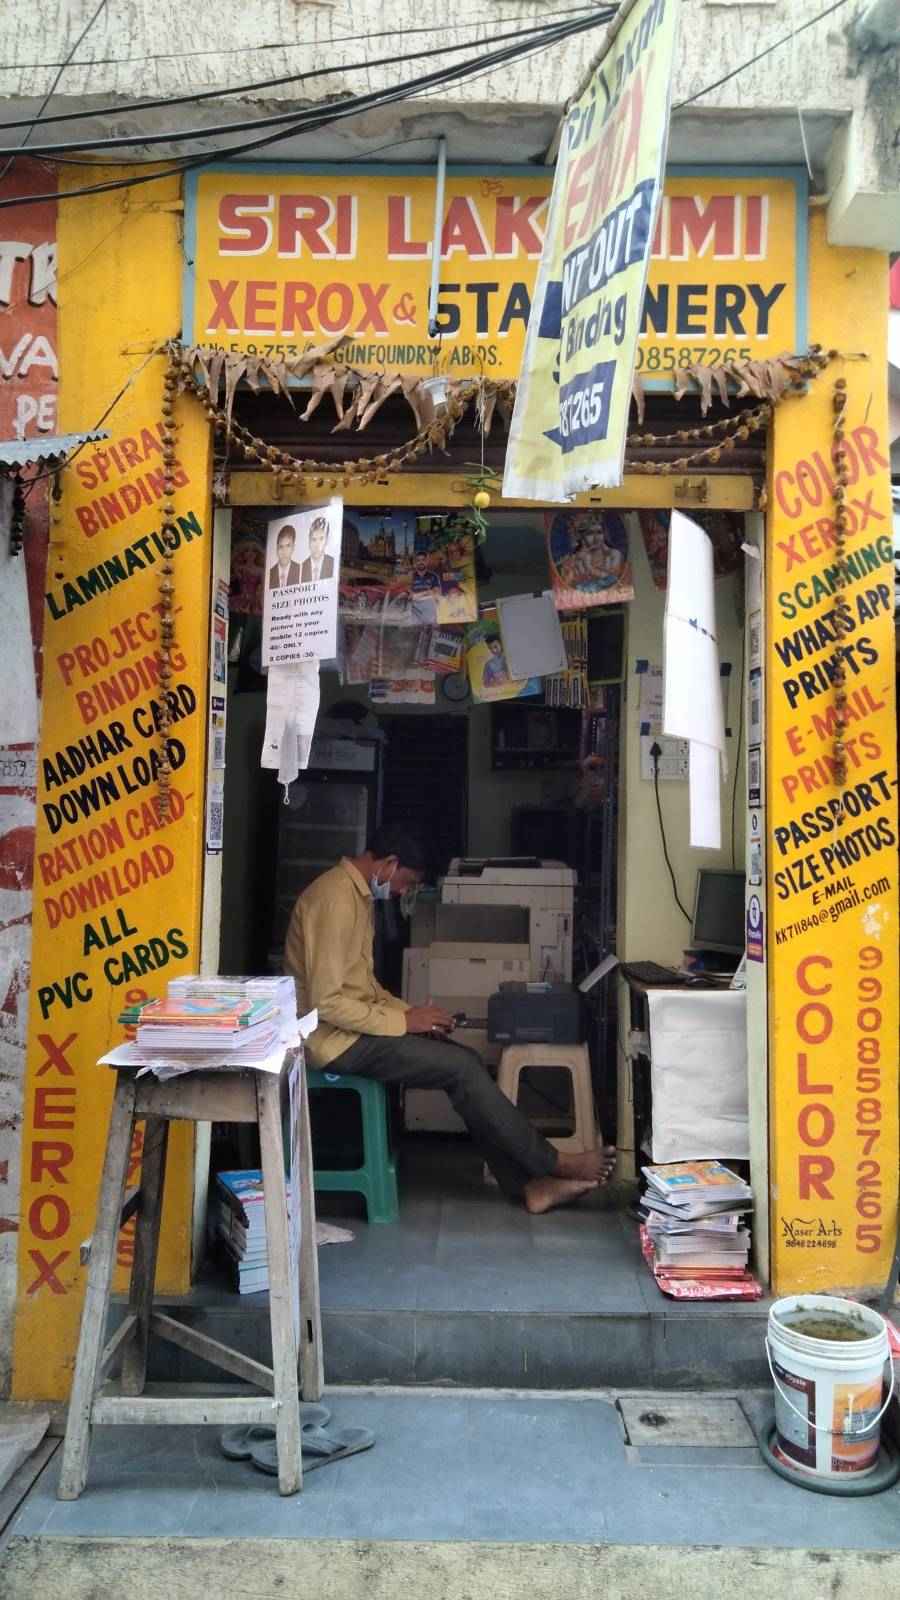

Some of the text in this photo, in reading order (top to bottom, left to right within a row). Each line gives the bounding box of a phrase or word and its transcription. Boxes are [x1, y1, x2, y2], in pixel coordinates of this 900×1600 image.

[217, 193, 769, 262] SRI LAKMI
[588, 202, 645, 288] OUT
[205, 279, 391, 337] XEROX
[391, 292, 417, 326] &
[75, 459, 191, 539] BINDING
[776, 489, 886, 573] XEROX
[46, 510, 205, 622] LAMINATION
[271, 595, 329, 610] SIZE PHOTOS
[272, 584, 318, 598] PASSPORT
[777, 534, 896, 621] SCANNING
[269, 633, 292, 641] mobile
[303, 629, 329, 637] copies
[270, 624, 294, 633] picture
[303, 619, 321, 628] your
[271, 614, 291, 622] Ready
[75, 642, 188, 727] BINDING
[275, 653, 301, 661] COPIES
[781, 636, 879, 710] PRINTS
[42, 683, 197, 793] AADHAR CARD
[780, 731, 882, 804] PRINTS
[37, 814, 126, 888] RATION
[774, 815, 897, 901] SIZE PHOTOS
[811, 875, 856, 906] E-MAIL
[82, 909, 137, 957] ALL
[37, 926, 190, 1021] PVC CARDS
[794, 954, 836, 1202] COLOR
[854, 944, 885, 1256] 9908587265
[25, 1032, 80, 1297] XEROX
